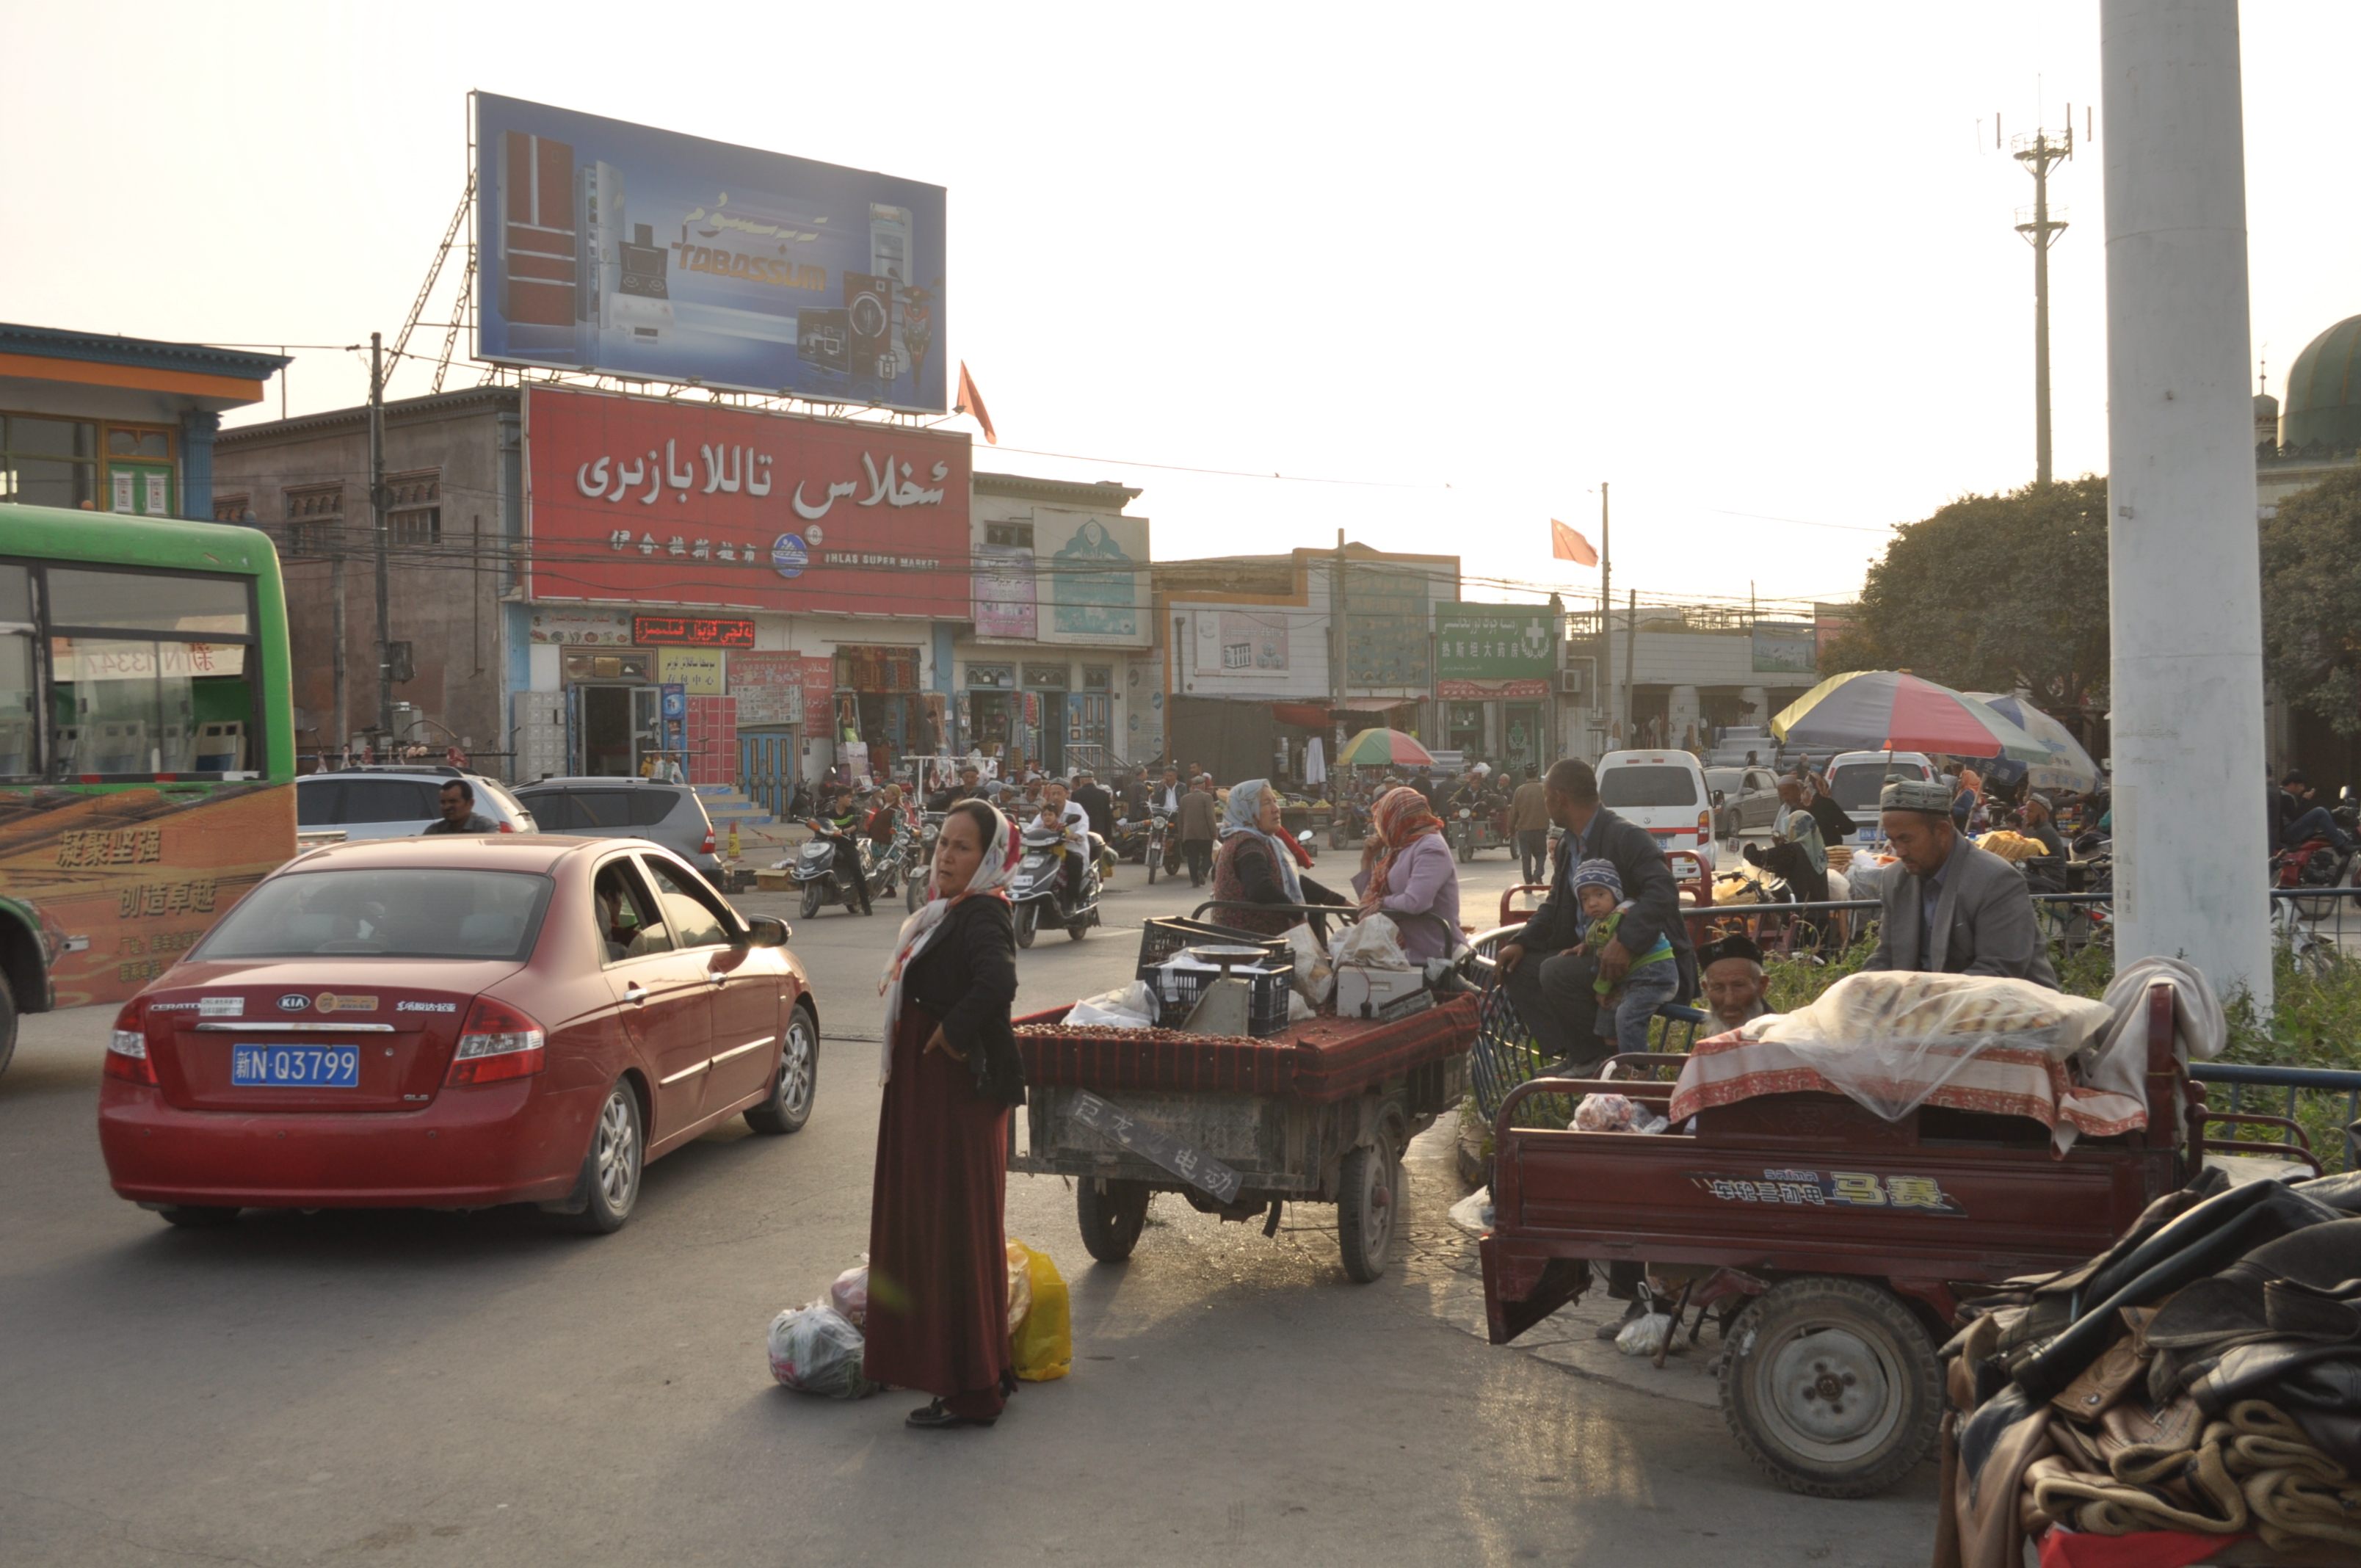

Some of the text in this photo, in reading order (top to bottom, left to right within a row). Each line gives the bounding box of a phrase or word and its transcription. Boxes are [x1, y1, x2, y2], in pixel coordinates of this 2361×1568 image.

[671, 242, 827, 291] TABASSUM
[825, 553, 940, 569] IHLAS SUPER MARKET
[1441, 641, 1518, 658] 热斯坦大药房
[57, 828, 160, 868] 凝聚坚强
[118, 880, 216, 918] 创造卓越
[150, 1003, 201, 1012] CERATO
[283, 997, 304, 1008] KIA
